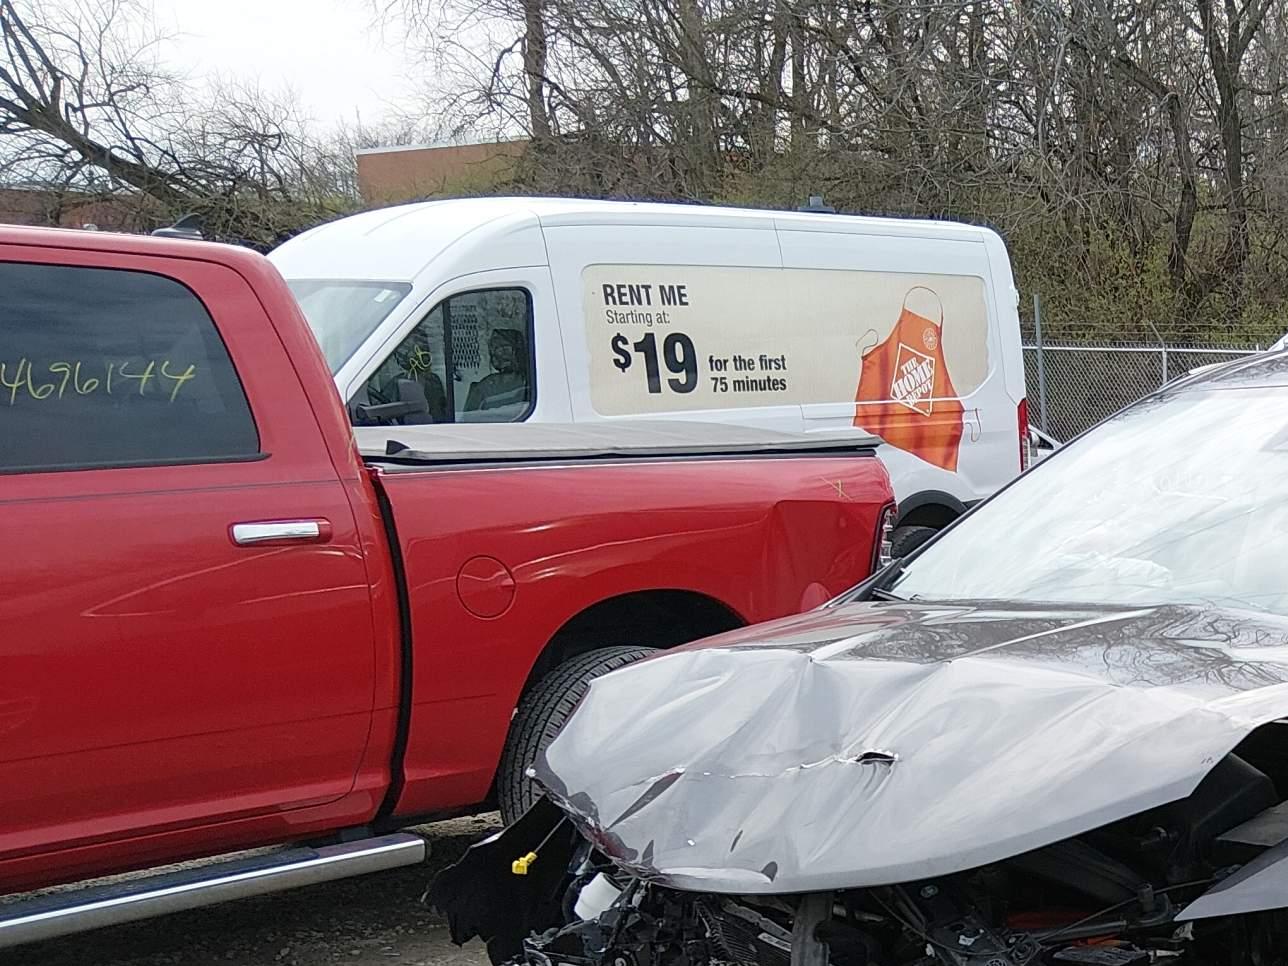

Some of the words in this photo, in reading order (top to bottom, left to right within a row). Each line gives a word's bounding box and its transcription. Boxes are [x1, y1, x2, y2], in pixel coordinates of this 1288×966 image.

[602, 283, 652, 306] RENT
[660, 285, 689, 306] ME
[606, 310, 653, 327] Starting
[655, 311, 671, 325] at:
[611, 332, 698, 394] $19
[708, 355, 731, 372] for
[733, 355, 757, 372] the
[760, 354, 787, 371] first
[710, 377, 730, 393] 75
[733, 376, 787, 393] minutes
[893, 358, 934, 400] HOME
